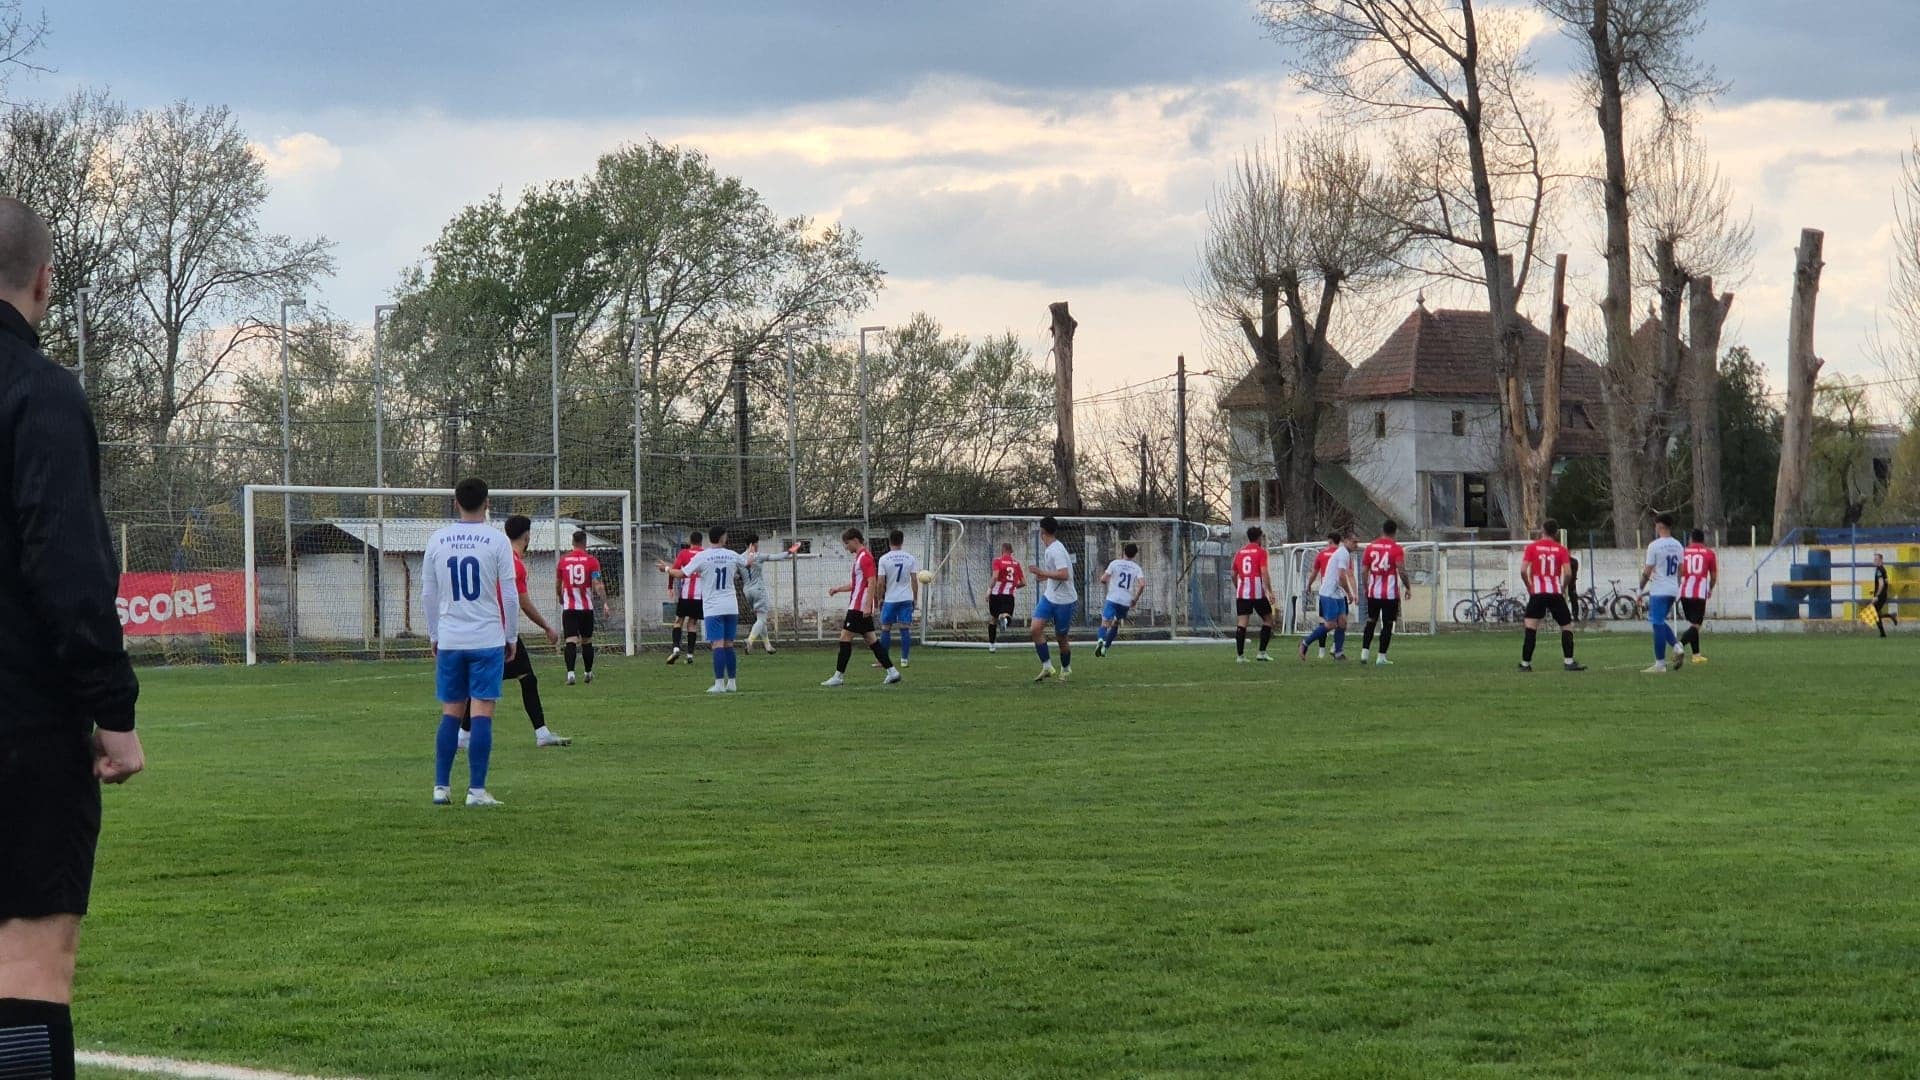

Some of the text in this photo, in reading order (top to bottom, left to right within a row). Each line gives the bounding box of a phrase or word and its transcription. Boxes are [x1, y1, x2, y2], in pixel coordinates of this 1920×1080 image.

[1242, 555, 1252, 574] 6
[1370, 550, 1391, 572] 24
[1538, 553, 1555, 577] 11
[1666, 554, 1678, 576] 16
[1684, 553, 1704, 574] 10
[446, 555, 481, 602] 10
[565, 563, 585, 585] 19
[715, 567, 727, 590] 11
[894, 563, 904, 582] 7
[1006, 566, 1015, 581] 3
[1118, 572, 1131, 590] 21
[114, 583, 216, 626] SCORE
